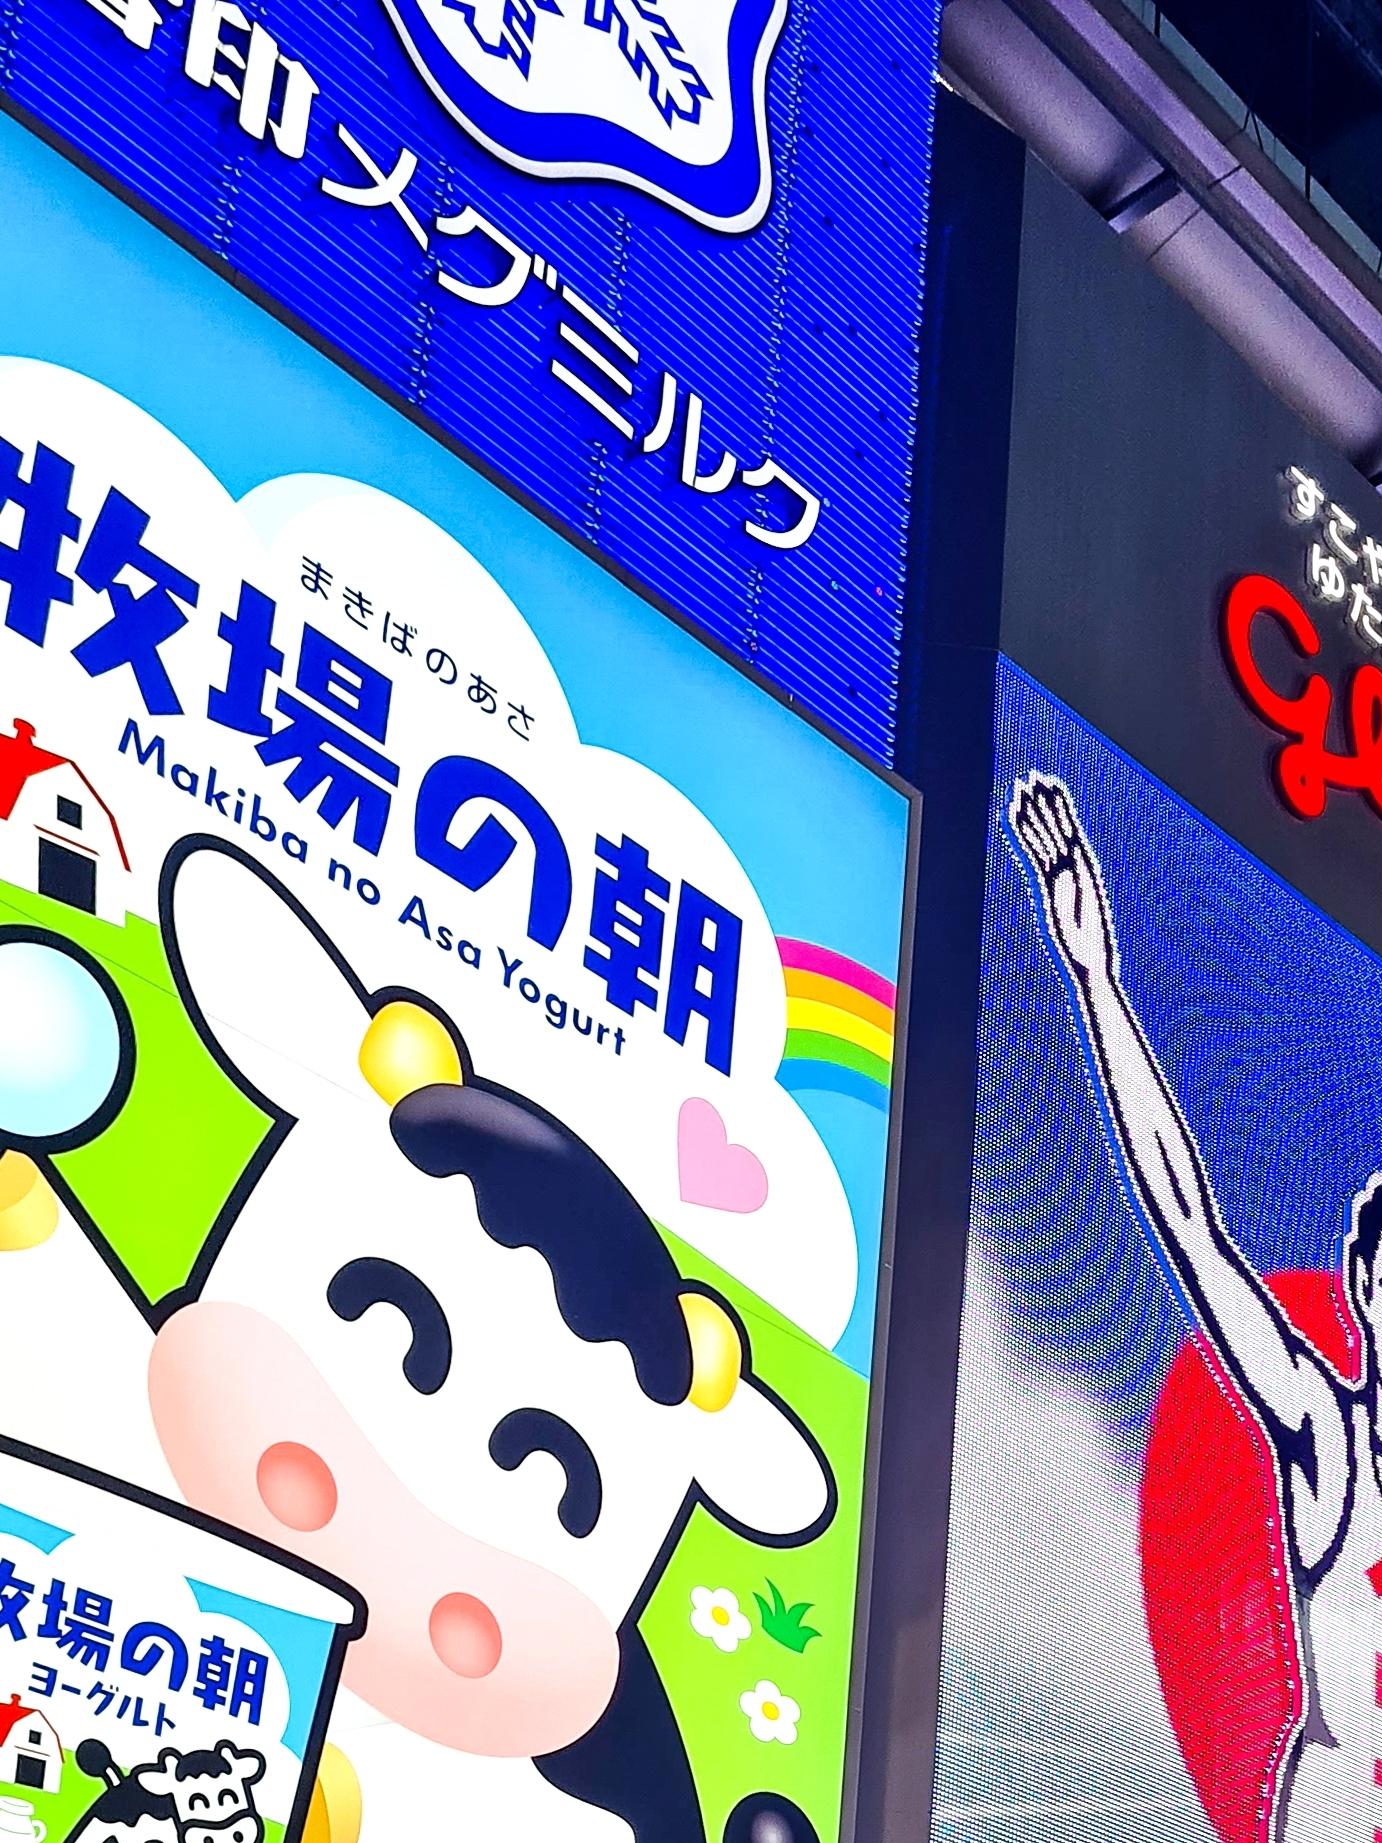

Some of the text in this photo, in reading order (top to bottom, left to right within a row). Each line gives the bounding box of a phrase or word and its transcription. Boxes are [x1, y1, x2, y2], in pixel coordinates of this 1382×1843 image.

[300, 554, 536, 743] まきばのあさ
[117, 718, 628, 1058] Makiba no Asa Yogurt
[27, 1661, 177, 1737] ヨーグルト
